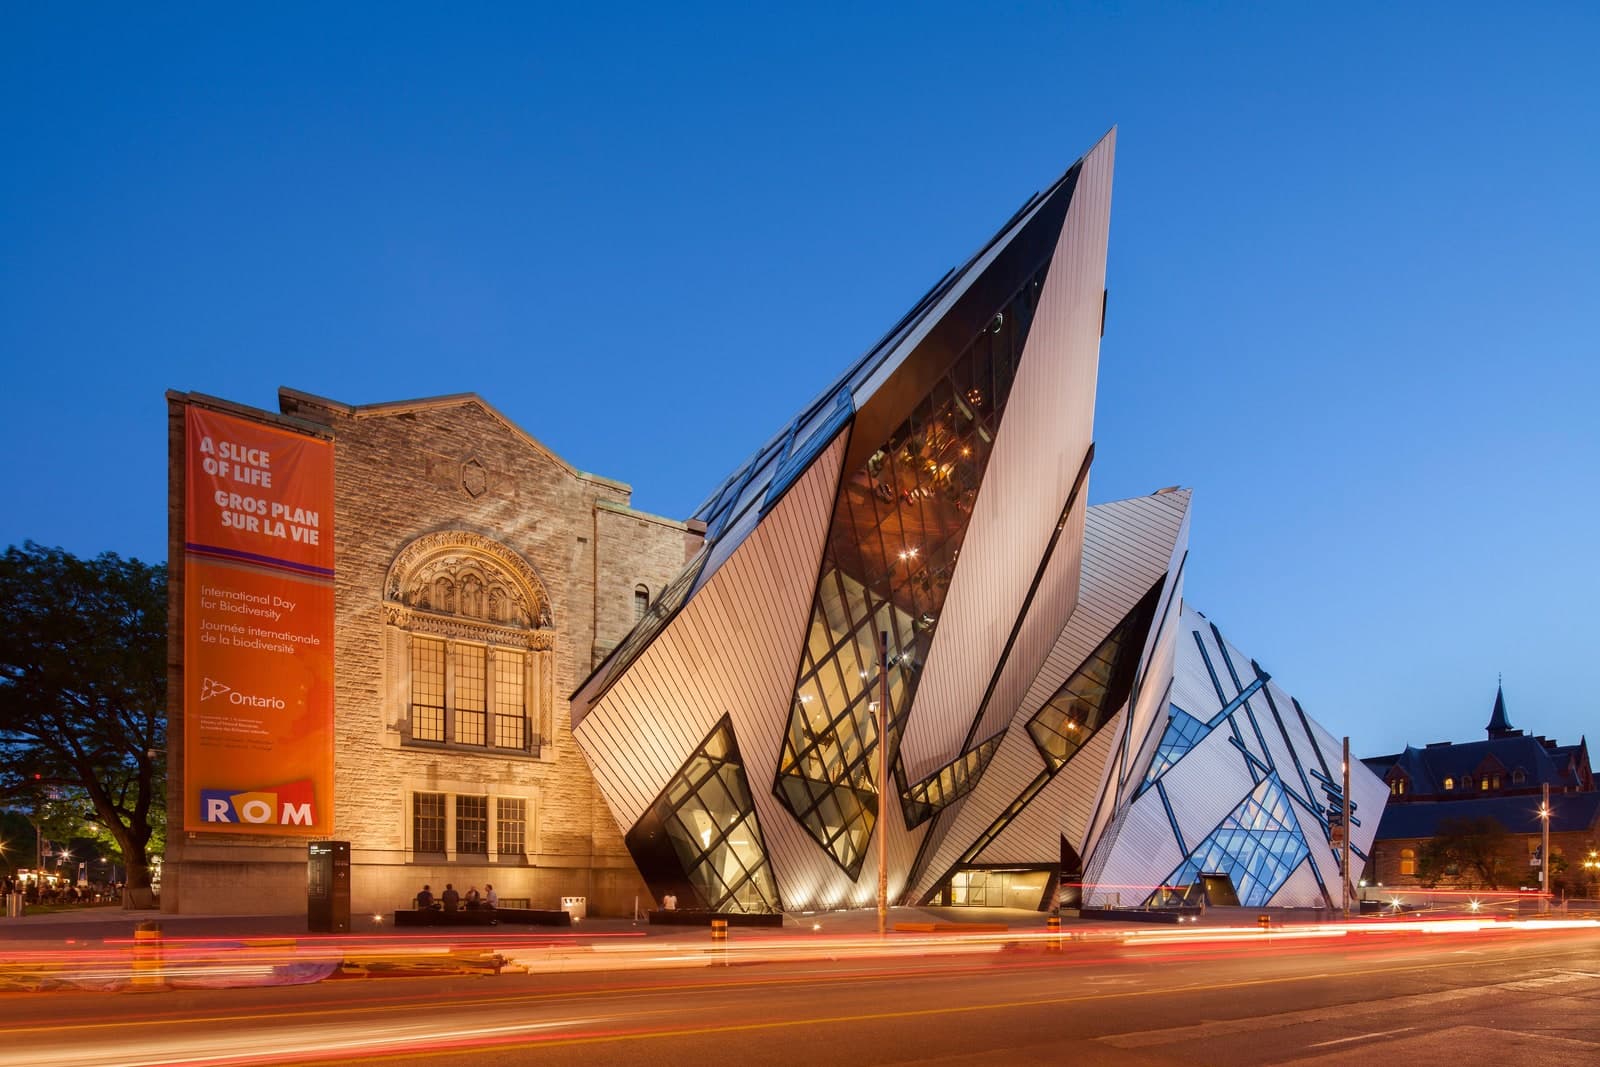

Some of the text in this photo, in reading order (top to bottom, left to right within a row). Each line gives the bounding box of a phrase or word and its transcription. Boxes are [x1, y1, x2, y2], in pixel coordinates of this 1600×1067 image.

[200, 436, 270, 469] A SLICE
[203, 457, 272, 488] OF LIFE
[214, 490, 319, 527] GROS PLAN
[221, 510, 319, 545] SUR LA VIE
[201, 585, 296, 612] International Day
[201, 598, 281, 622] for Biodiversity
[200, 619, 320, 645] Journée internationale
[201, 632, 295, 654] de la biodiversité
[229, 692, 285, 709] Ontario
[207, 798, 313, 826] ROM
